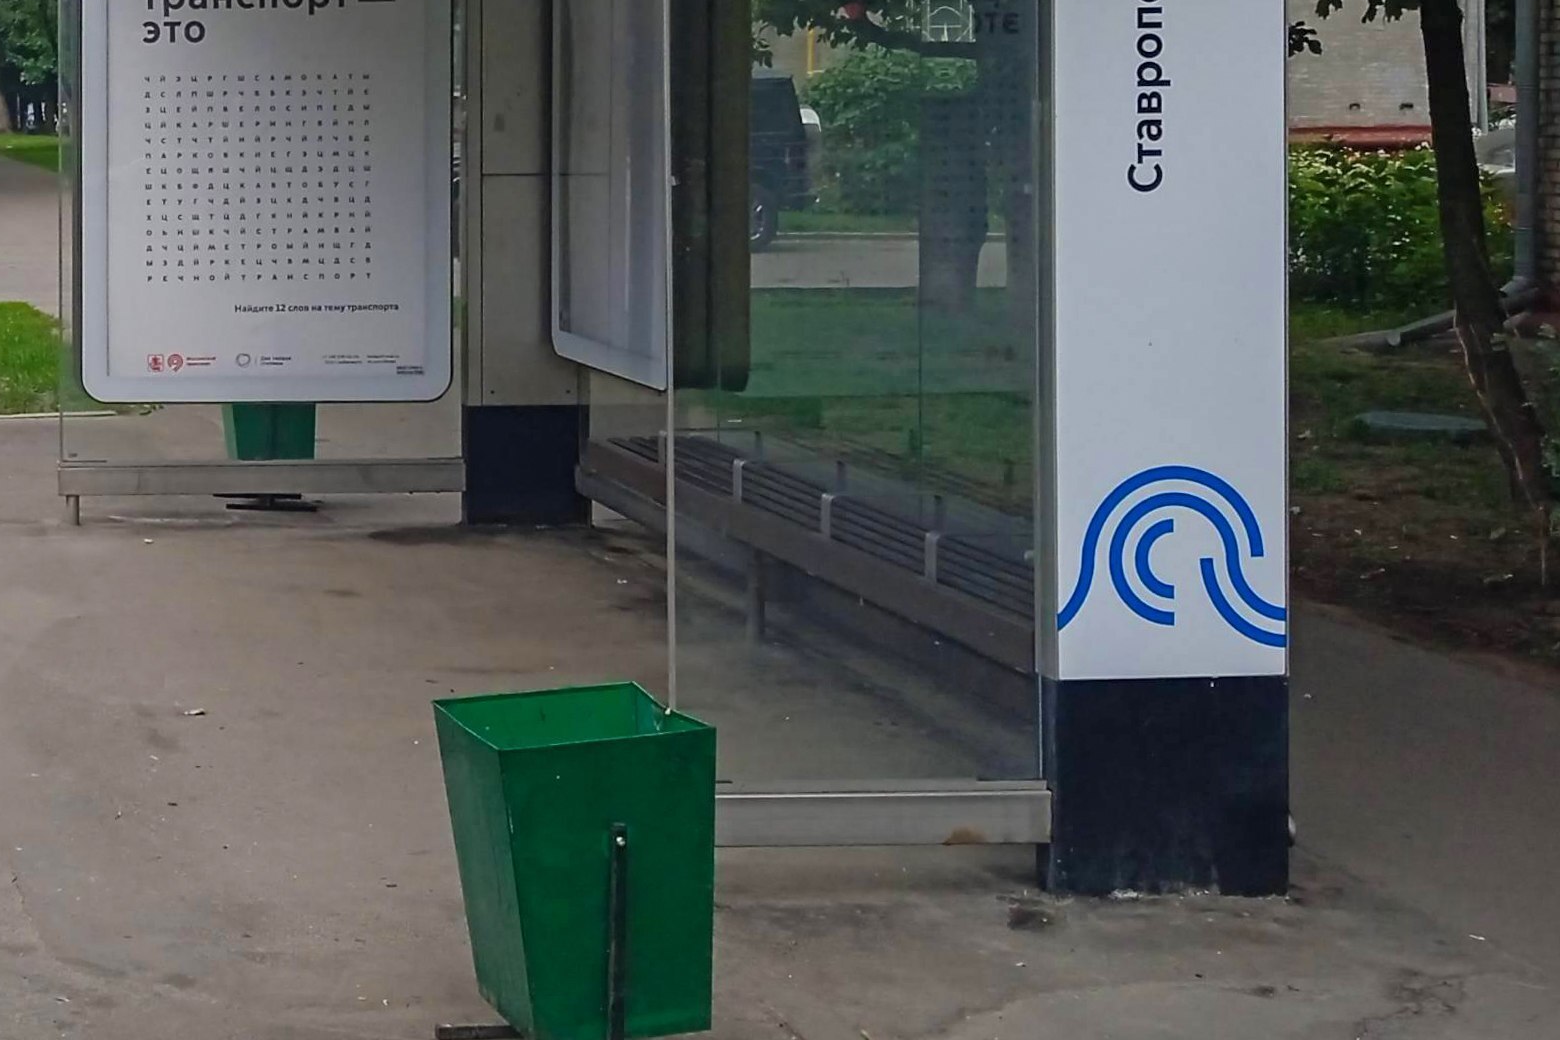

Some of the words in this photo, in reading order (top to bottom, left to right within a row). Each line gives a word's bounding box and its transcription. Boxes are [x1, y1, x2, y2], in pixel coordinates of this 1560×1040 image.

[142, 20, 206, 43] это
[234, 304, 274, 313] Найдите
[275, 303, 287, 312] 12
[324, 304, 346, 313] тему
[347, 304, 400, 313] транспорта
